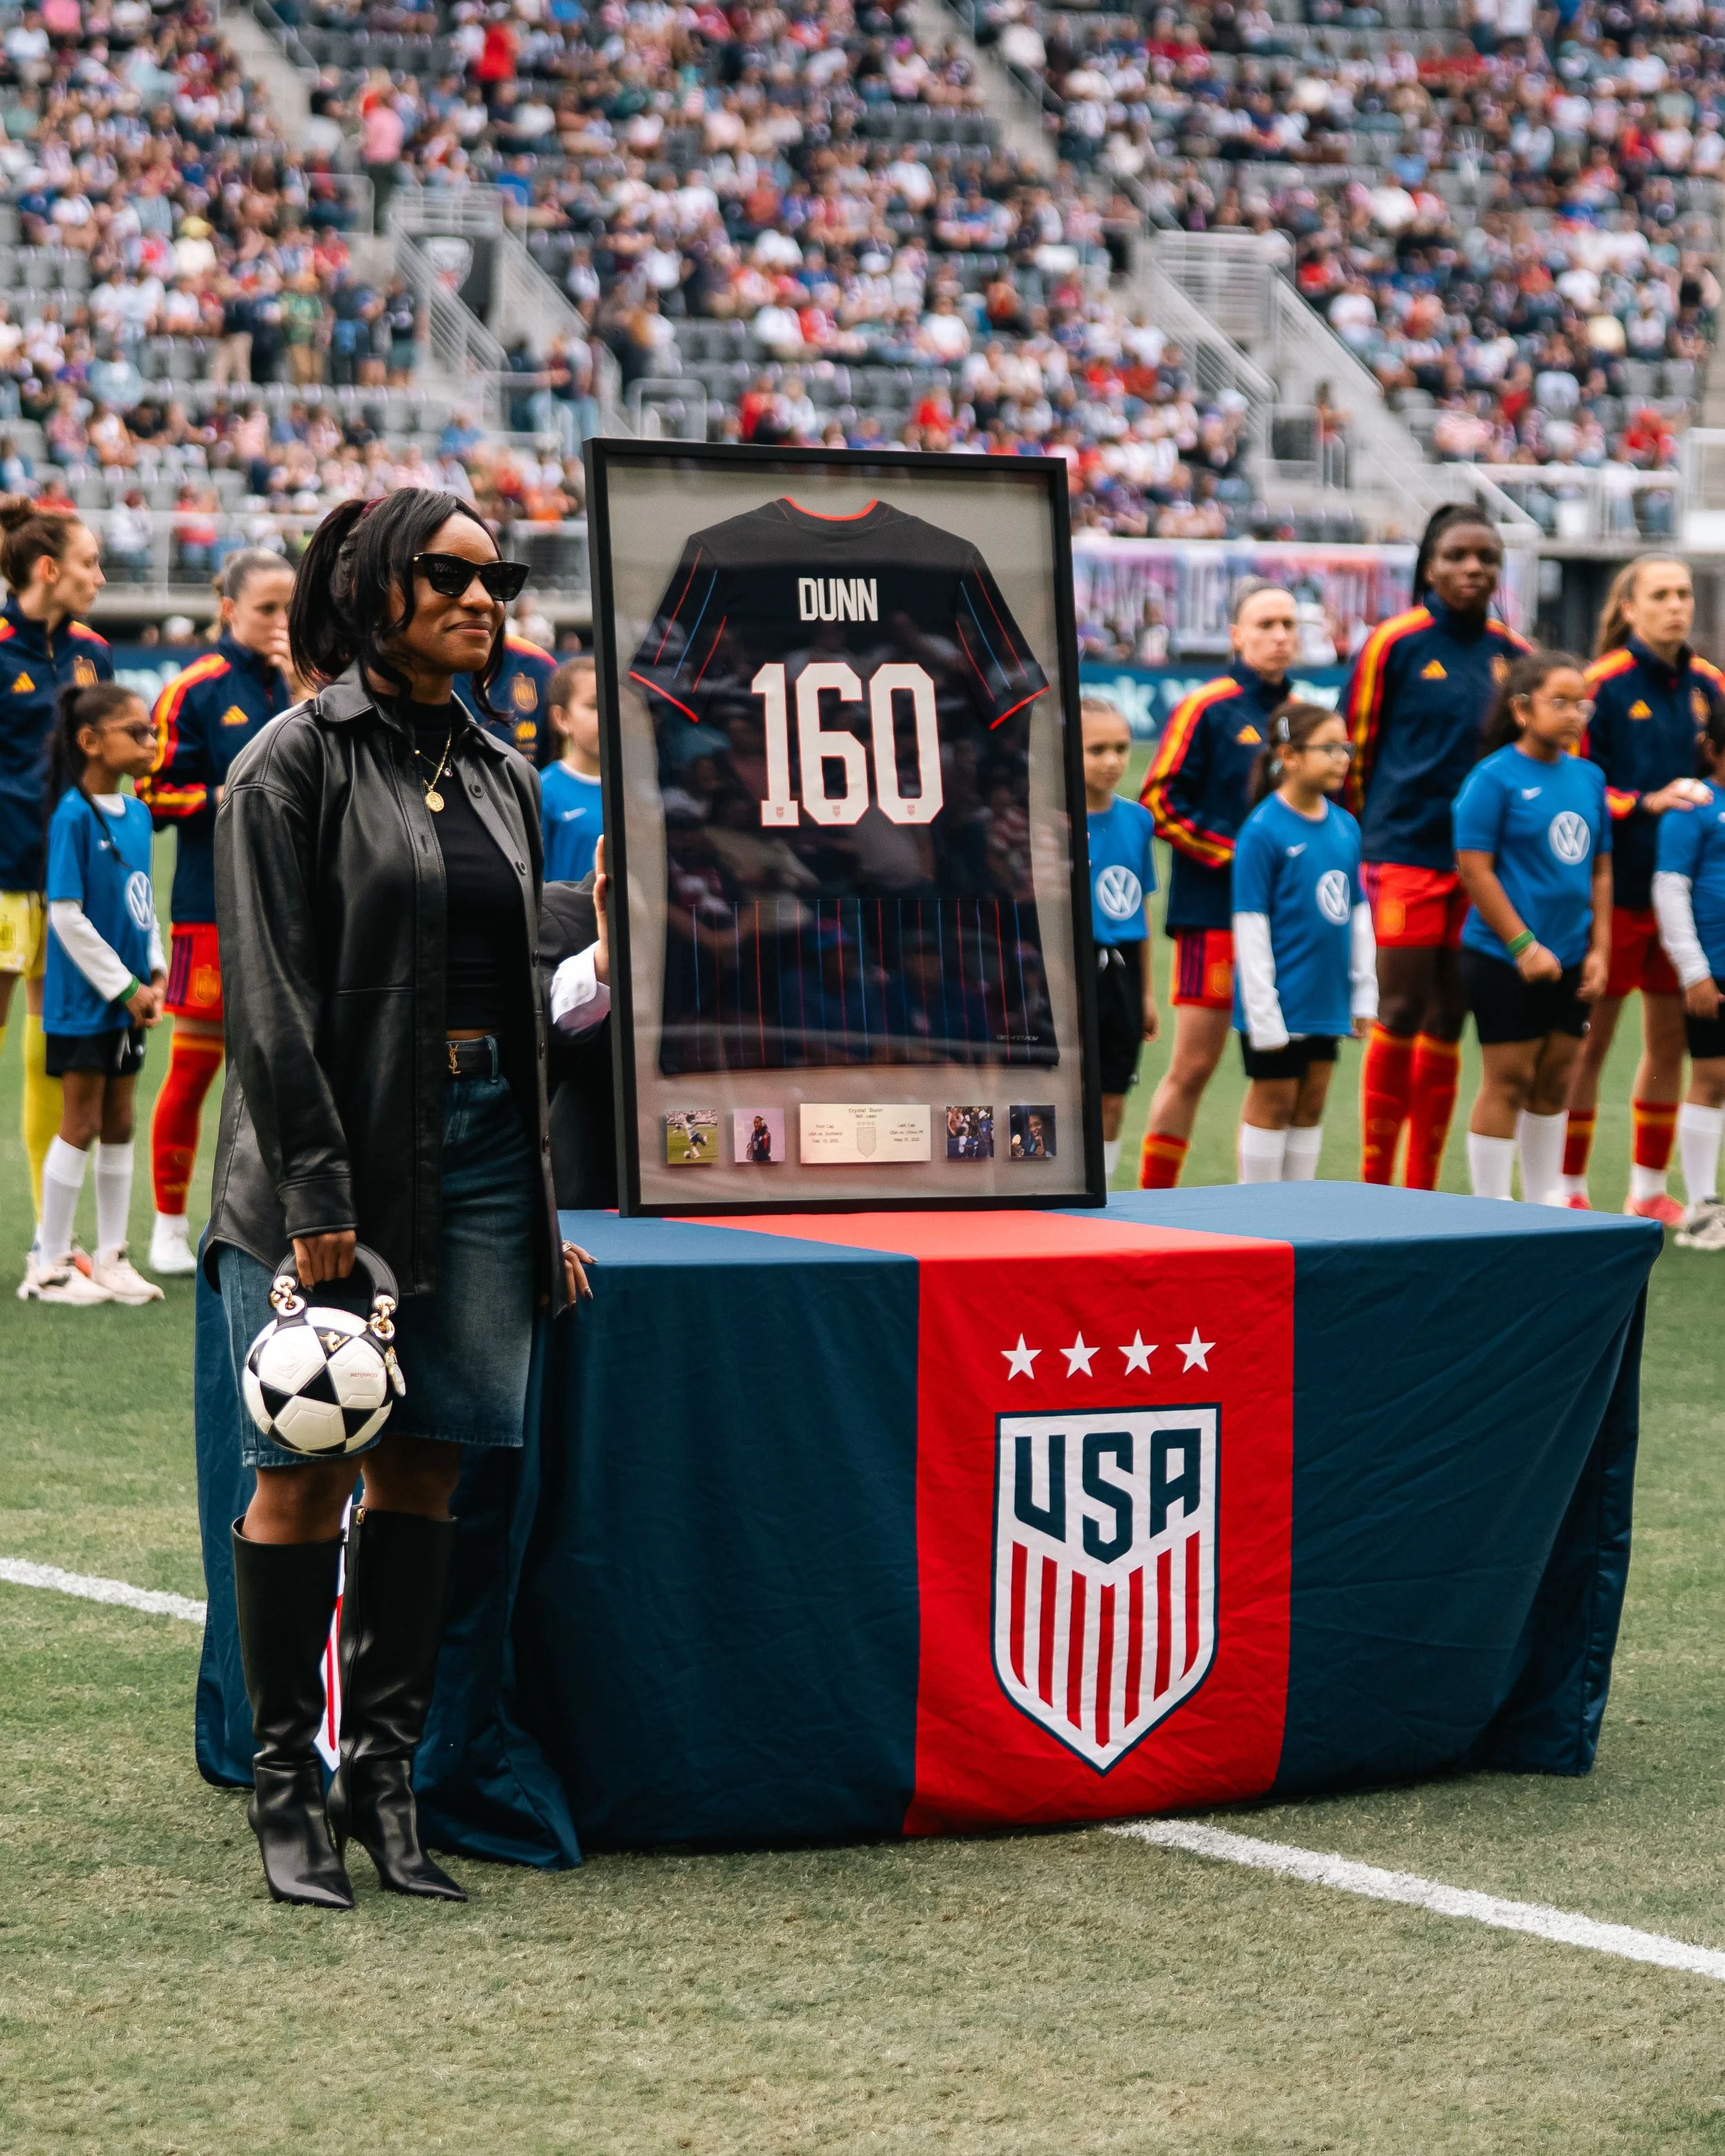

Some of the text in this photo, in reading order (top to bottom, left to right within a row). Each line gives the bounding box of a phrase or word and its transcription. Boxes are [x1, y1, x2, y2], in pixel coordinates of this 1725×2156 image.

[798, 577, 878, 622] DUNN
[751, 662, 944, 827] 160
[1014, 1427, 1201, 1564] USA
